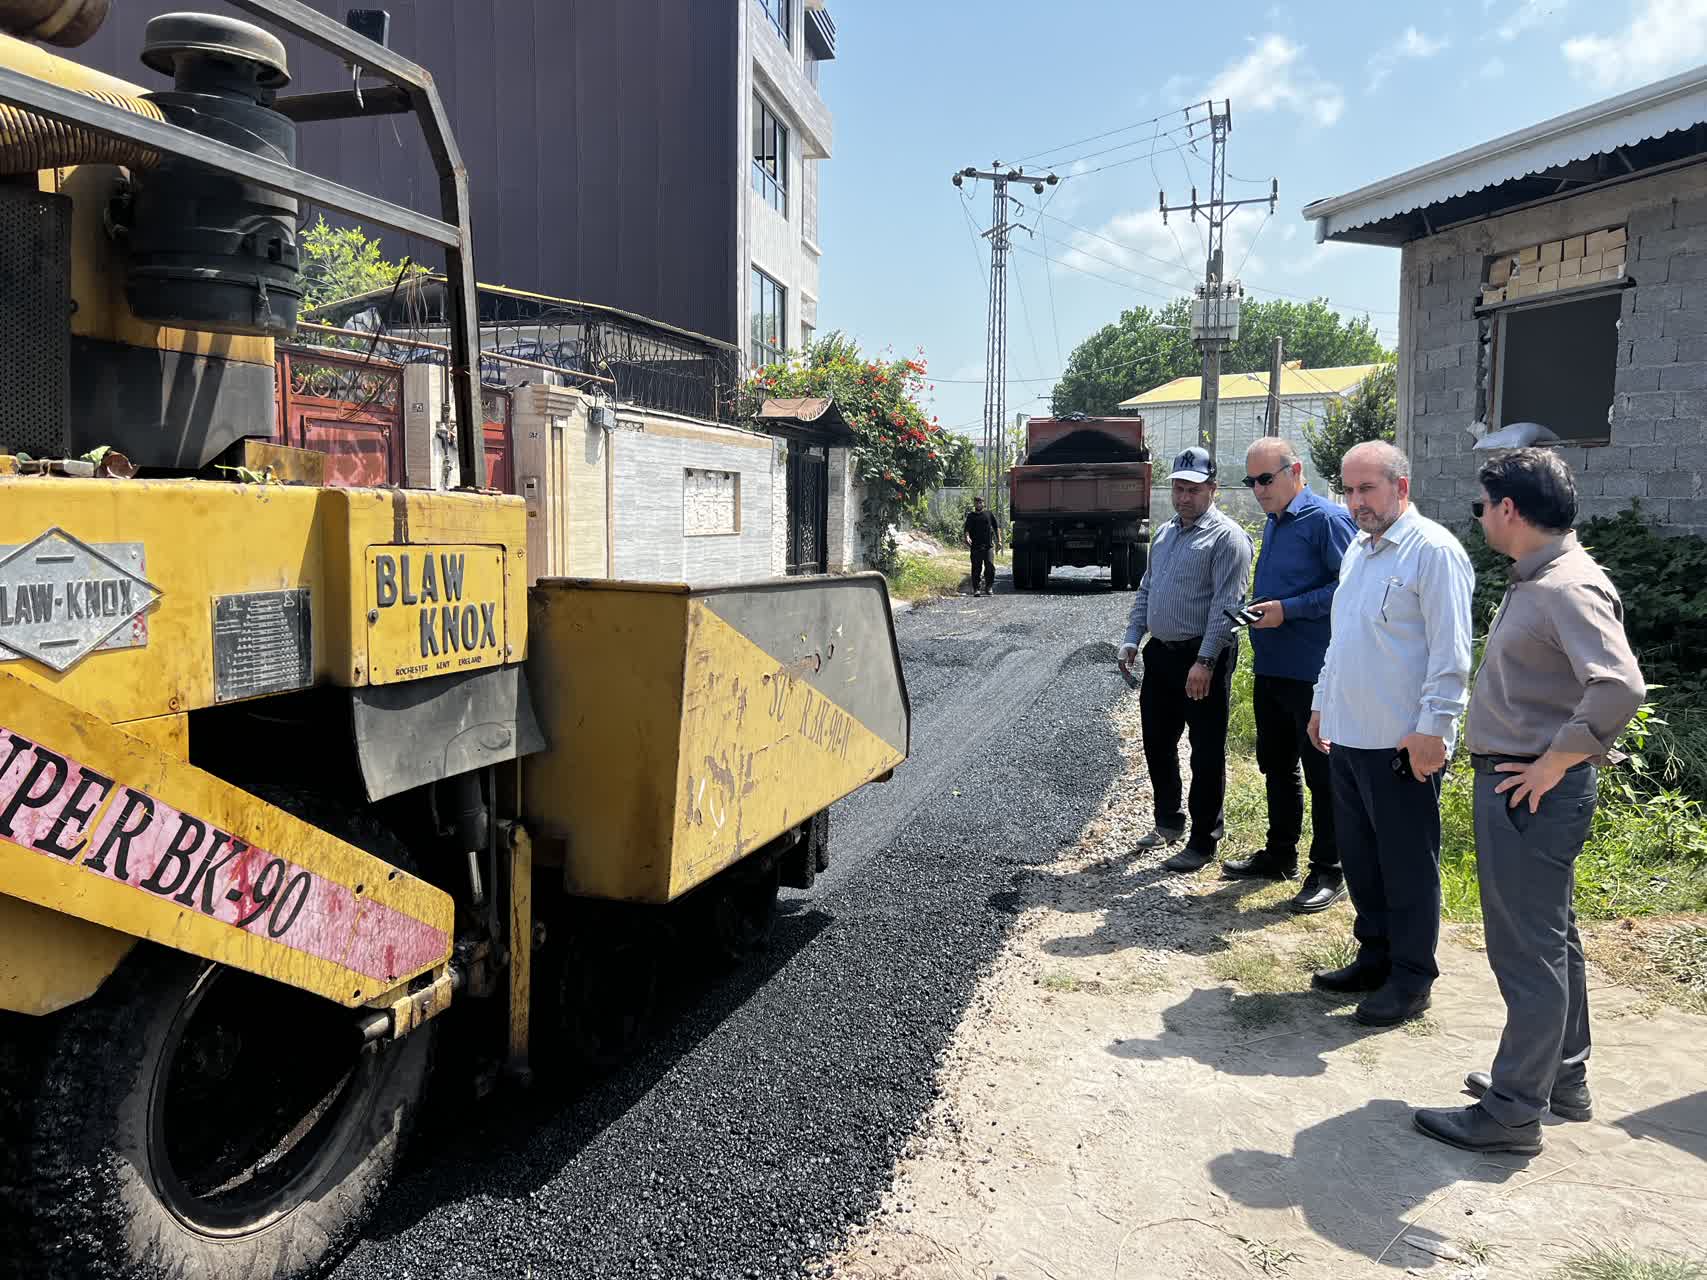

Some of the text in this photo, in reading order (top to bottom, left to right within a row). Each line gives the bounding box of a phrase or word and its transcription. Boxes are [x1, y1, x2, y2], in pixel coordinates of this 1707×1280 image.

[1180, 450, 1195, 468] NY
[375, 552, 465, 608] BLAW
[419, 602, 496, 658] KNOX
[395, 656, 482, 676] ROCHESTER KENT ENGLAND
[140, 813, 311, 938] BK-90
